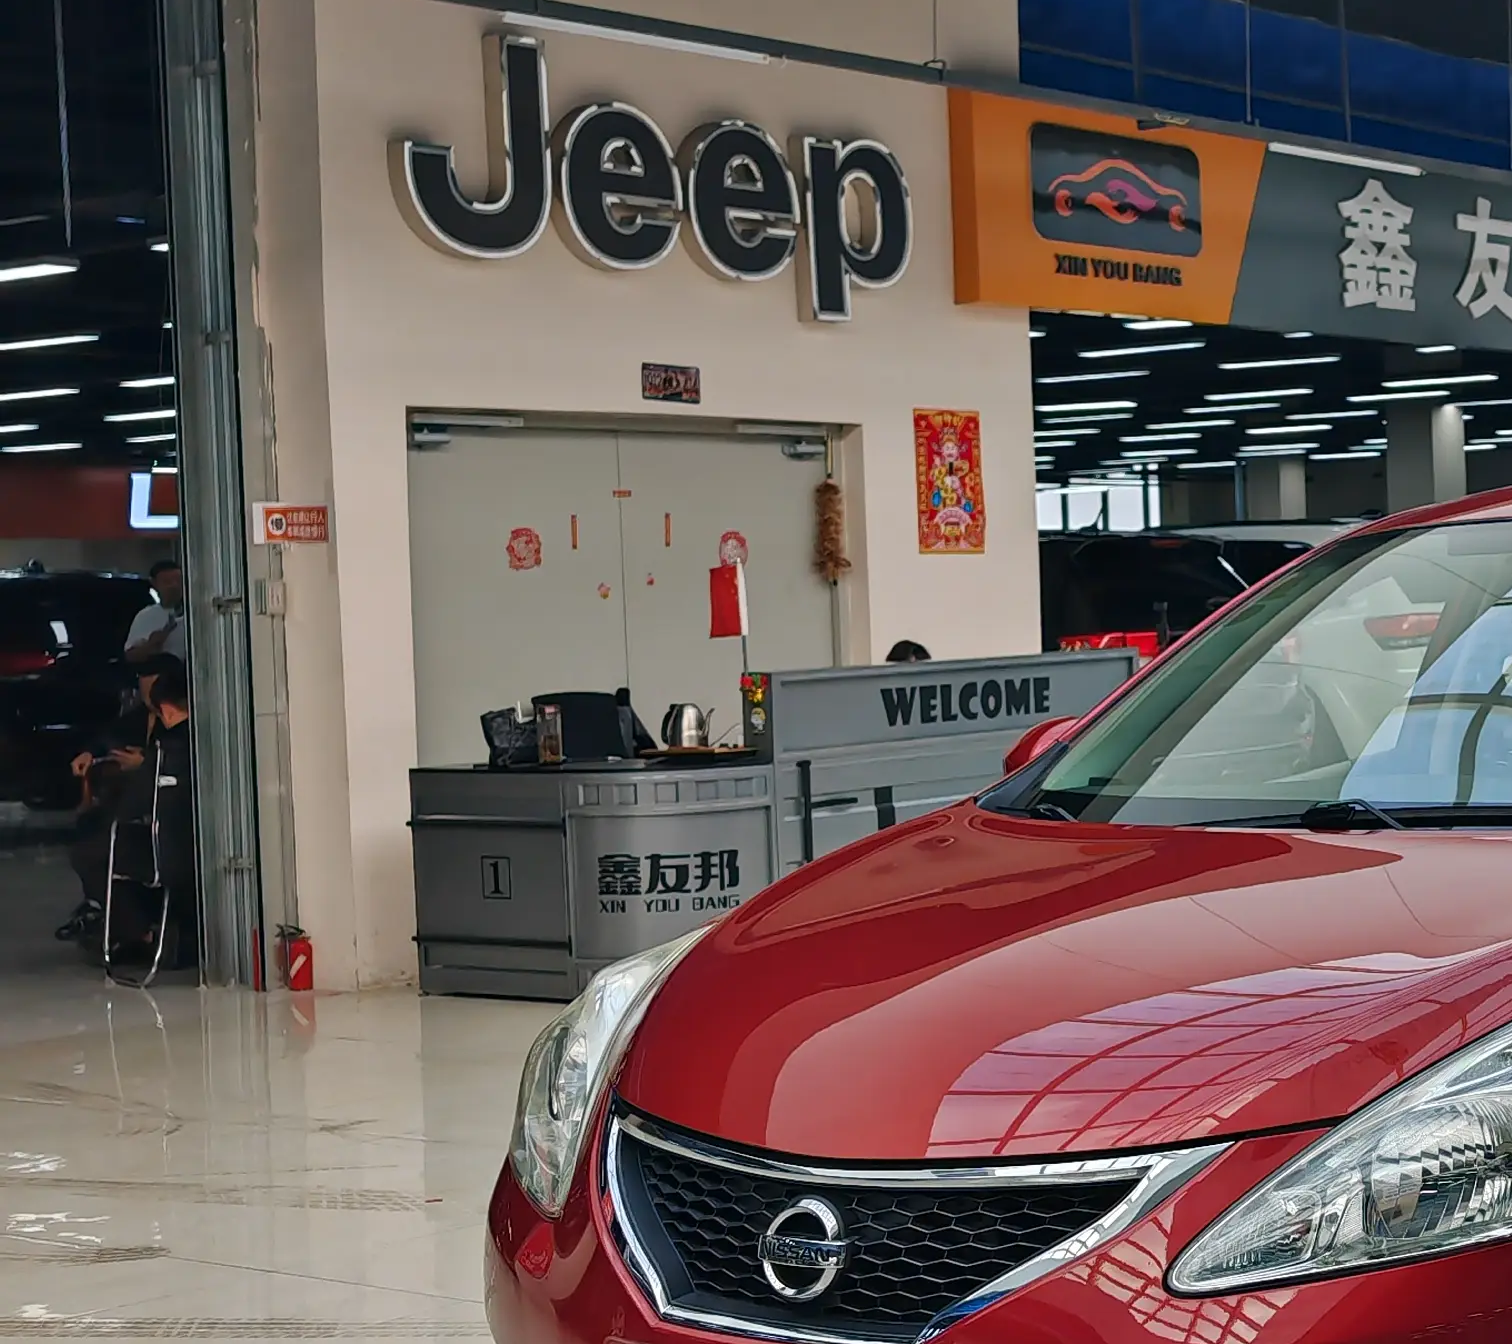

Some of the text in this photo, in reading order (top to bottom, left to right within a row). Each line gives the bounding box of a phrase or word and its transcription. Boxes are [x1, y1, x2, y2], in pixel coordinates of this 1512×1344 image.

[387, 33, 914, 323] Jeep
[1054, 253, 1182, 286] XIN YOU BANG
[880, 676, 1050, 727] WELCOME
[489, 860, 505, 895] 1
[598, 849, 740, 896] 鑫友邦
[599, 894, 740, 913] XIN YOU BANG
[763, 1237, 831, 1264] NISSAN
